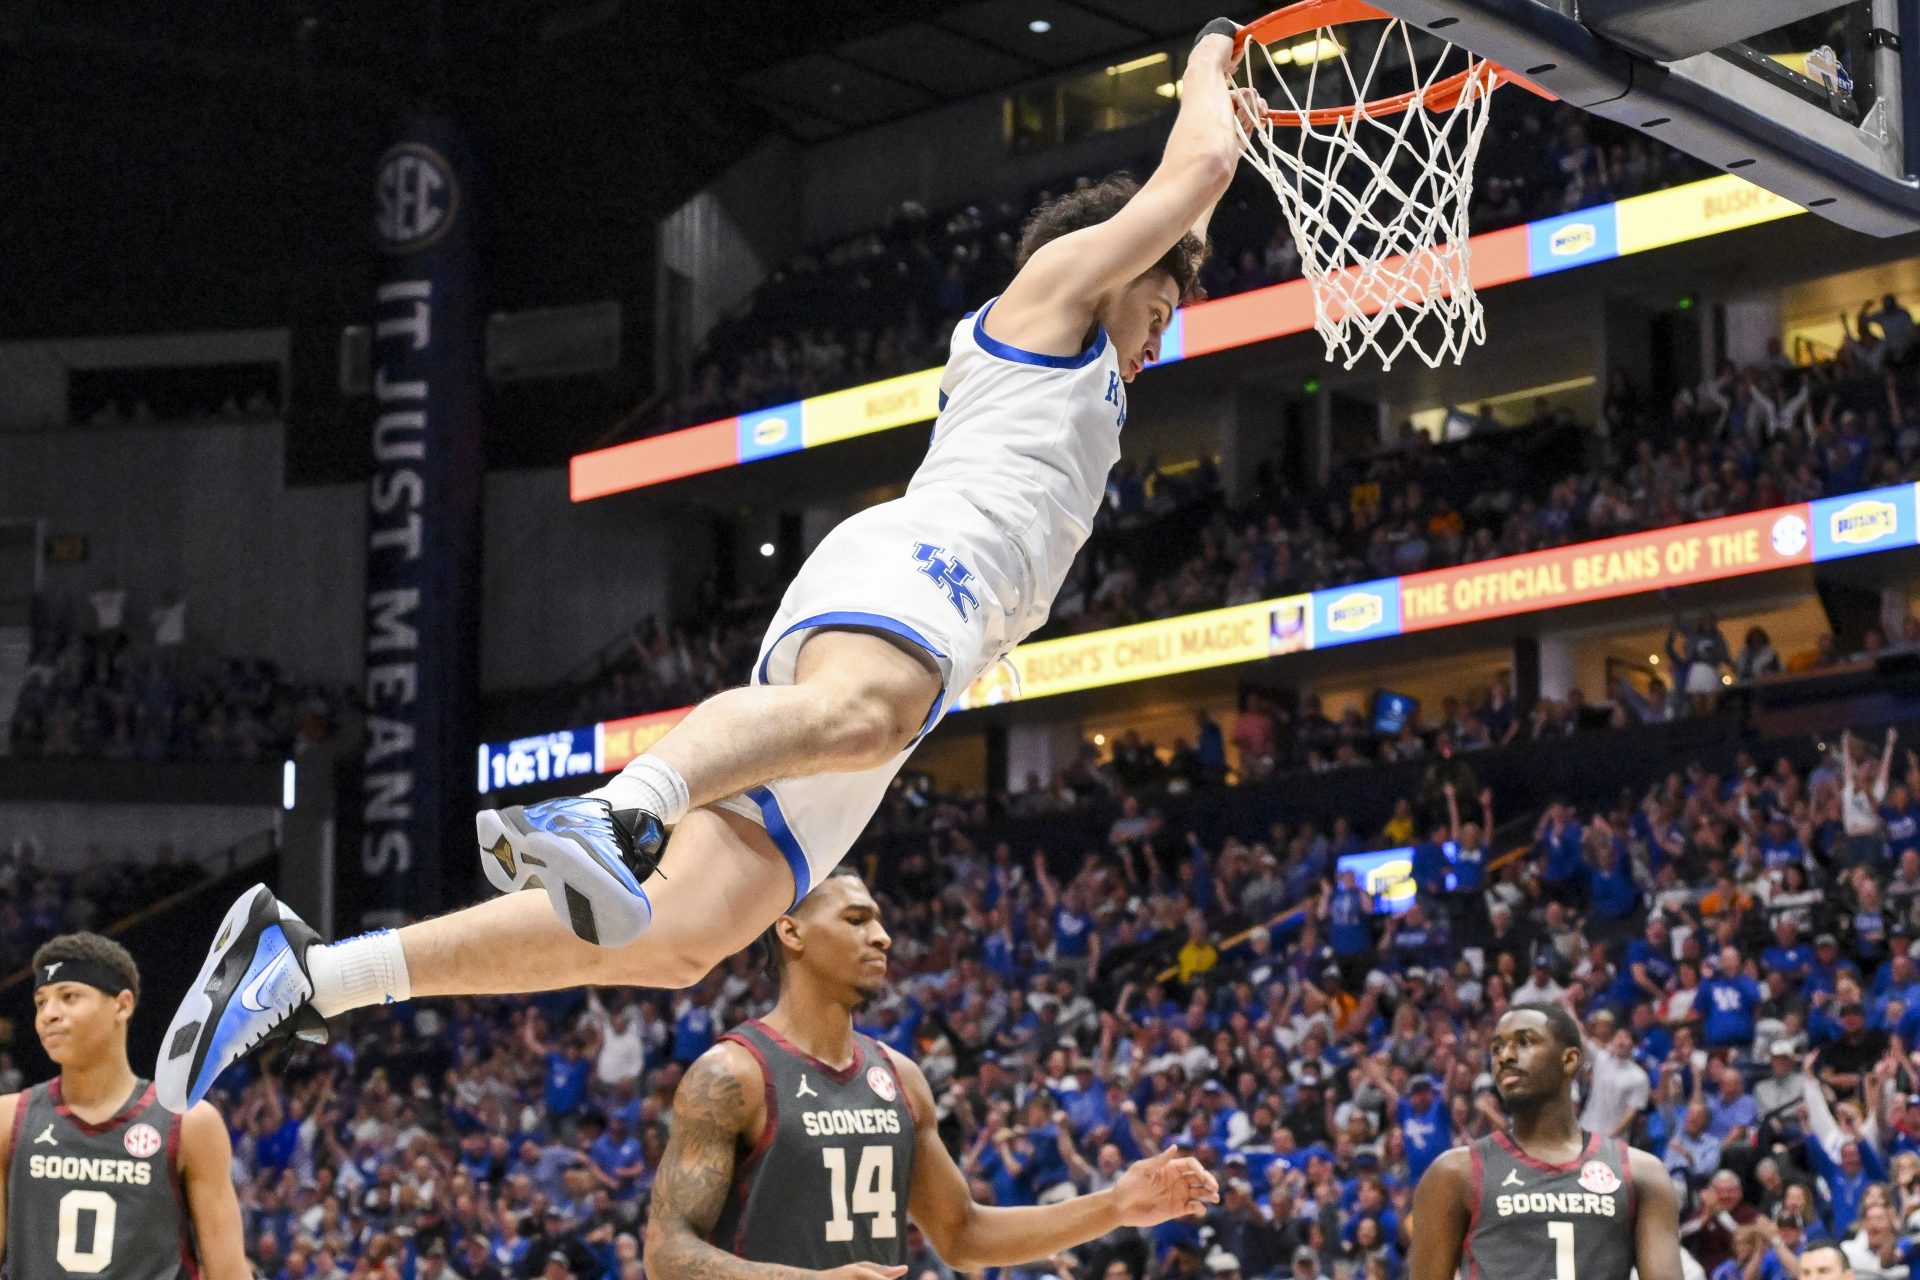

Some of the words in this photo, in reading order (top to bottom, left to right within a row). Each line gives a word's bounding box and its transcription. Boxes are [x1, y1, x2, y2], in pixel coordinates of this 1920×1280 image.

[373, 155, 443, 241] SEC
[377, 280, 432, 350] IT
[371, 365, 428, 560] JUST
[1402, 582, 1449, 620] THE
[1453, 561, 1568, 611] OFFICIAL
[1572, 544, 1661, 591] BEANS
[1665, 537, 1704, 575] OF
[1706, 528, 1761, 570] THE
[1025, 645, 1105, 684] BUSH'S
[1114, 633, 1171, 669] CHILI
[1181, 618, 1254, 656] MAGIC
[361, 587, 421, 877] MEANS
[802, 1108, 901, 1136] SOONERS
[29, 1154, 152, 1186] SOONERS
[822, 1145, 897, 1242] 14
[1496, 1192, 1616, 1218] SOONERS
[56, 1189, 117, 1273] 0
[1547, 1221, 1576, 1280] 1
